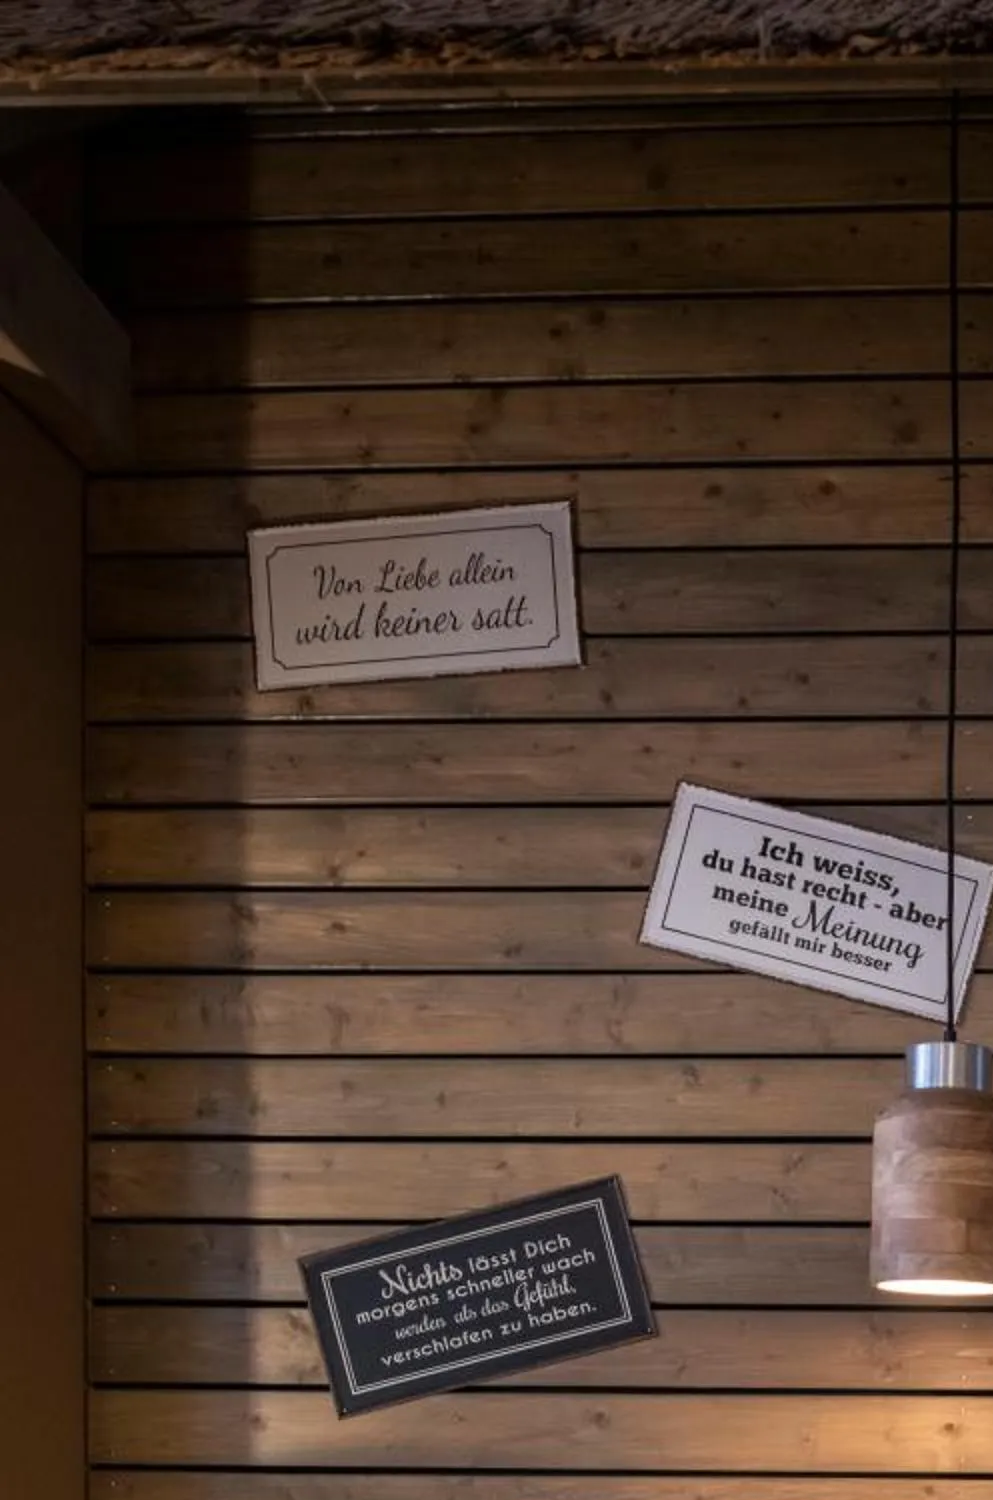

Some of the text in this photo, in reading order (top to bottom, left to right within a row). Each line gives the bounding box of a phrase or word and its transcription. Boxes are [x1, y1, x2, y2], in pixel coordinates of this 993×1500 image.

[313, 552, 516, 599] Von Liebe allein
[296, 595, 533, 645] wird keiner satt.
[702, 849, 734, 873] du
[740, 857, 797, 890] hast
[802, 878, 868, 909] recht
[889, 900, 948, 931] aber
[758, 836, 901, 897] Ich weiss,
[712, 884, 924, 968] meine Meinung
[729, 917, 892, 972] gefällt mir besser
[356, 1248, 597, 1325] morgens schneller wach
[378, 1261, 463, 1299] Nichts
[468, 1248, 517, 1275] lässt
[380, 1301, 598, 1367] verschlafen zu haben.
[454, 1303, 478, 1325] als
[480, 1297, 510, 1319] das
